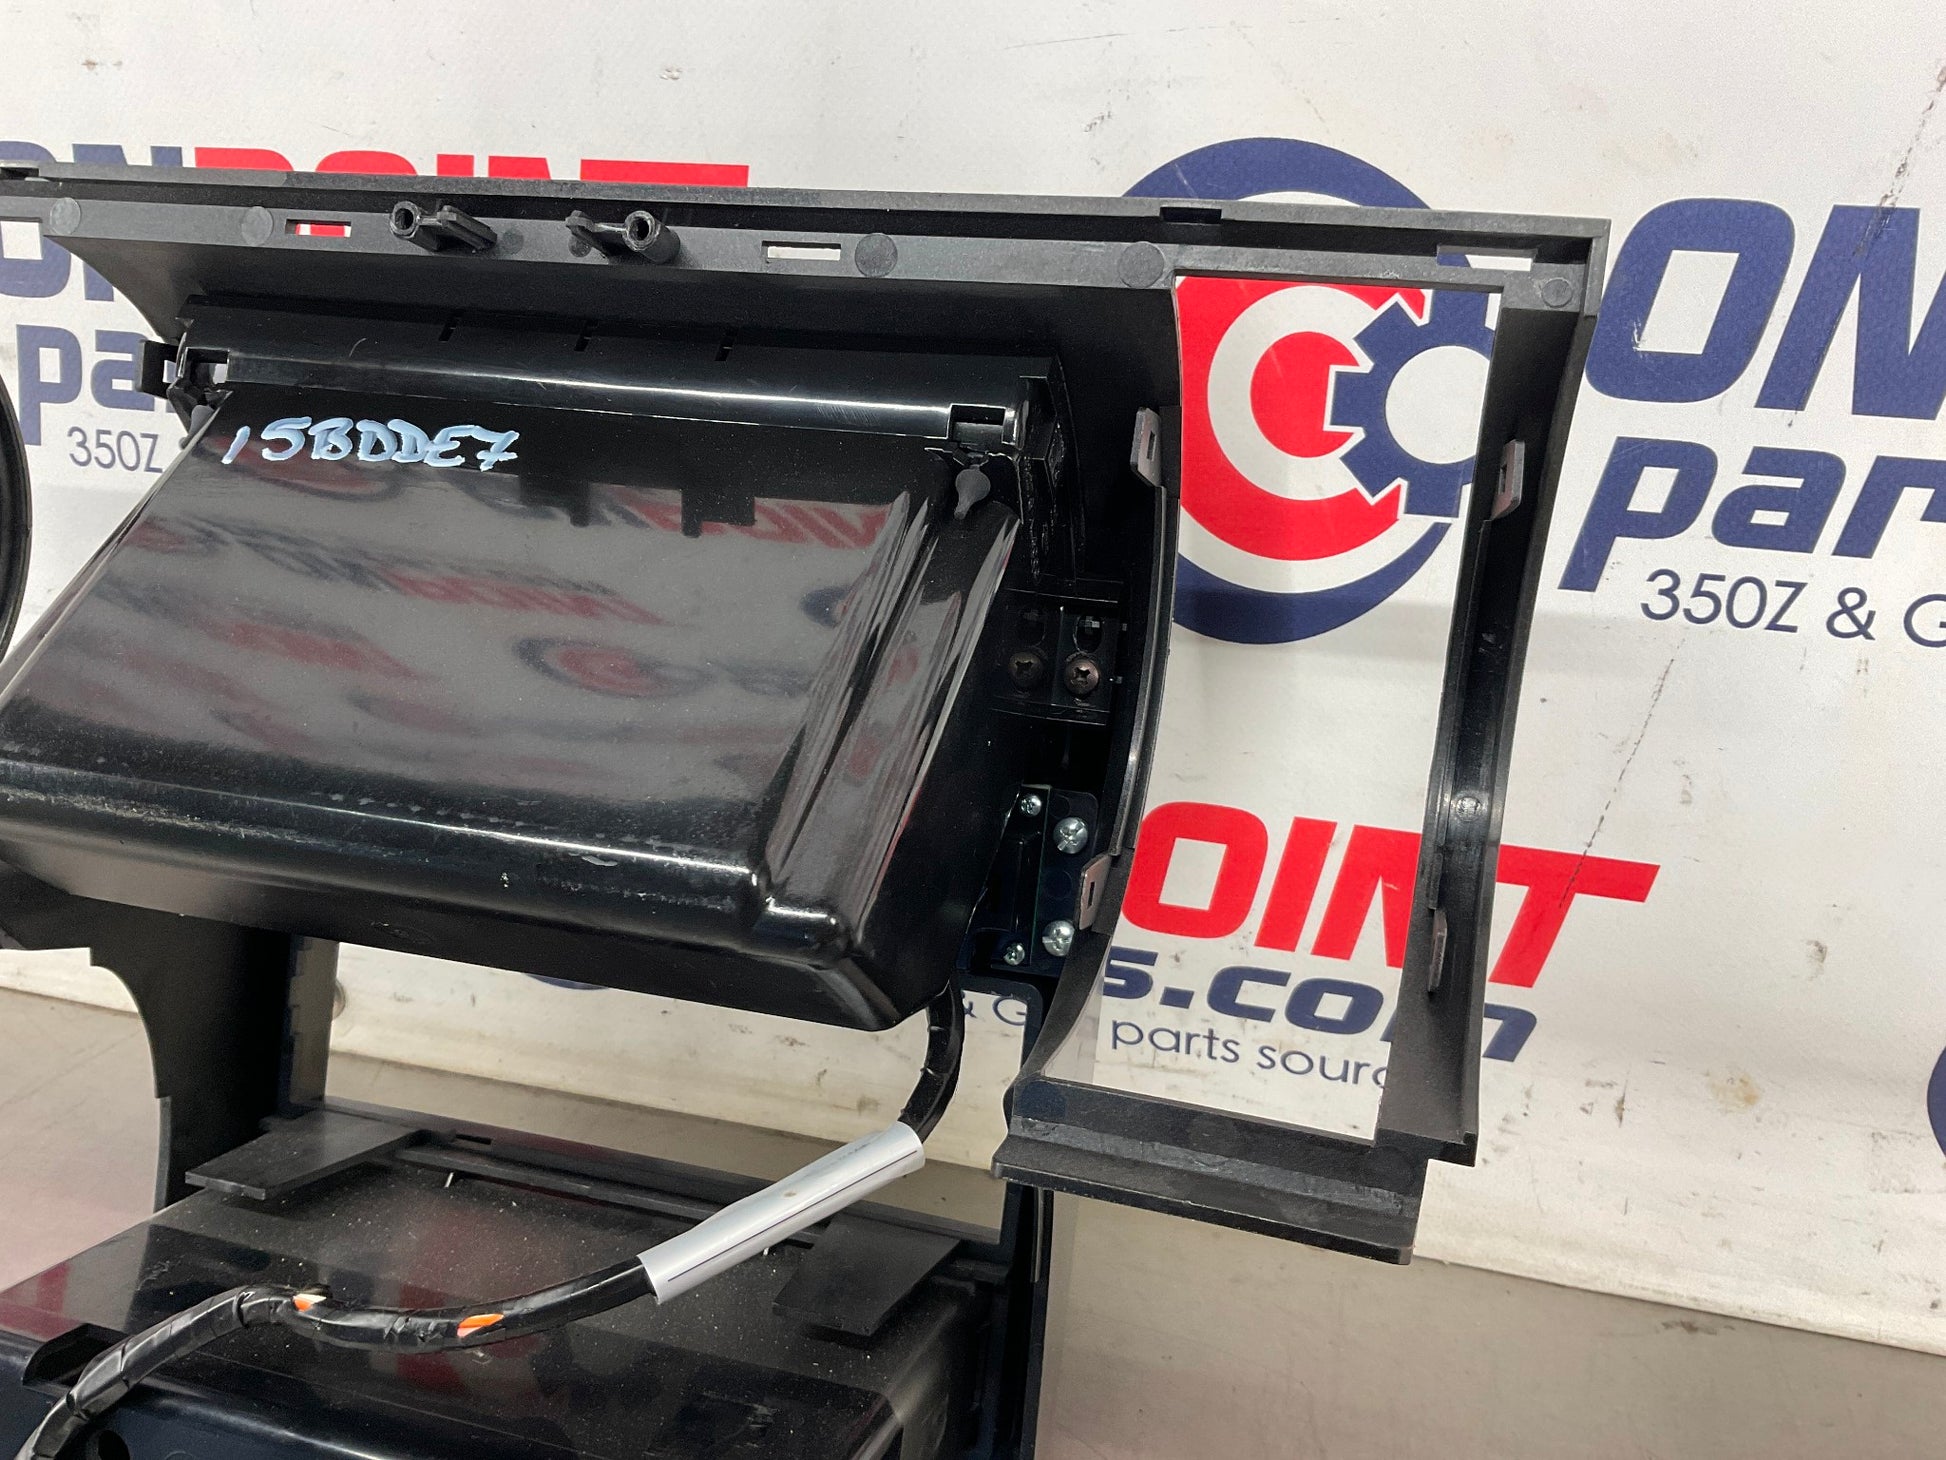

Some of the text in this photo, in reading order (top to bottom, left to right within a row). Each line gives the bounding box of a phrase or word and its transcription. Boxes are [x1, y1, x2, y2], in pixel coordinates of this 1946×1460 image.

[68, 426, 163, 474] 350Z
[1641, 568, 1808, 633] 350Z
[1825, 587, 1876, 641] &
[1112, 1019, 1240, 1064] parts
